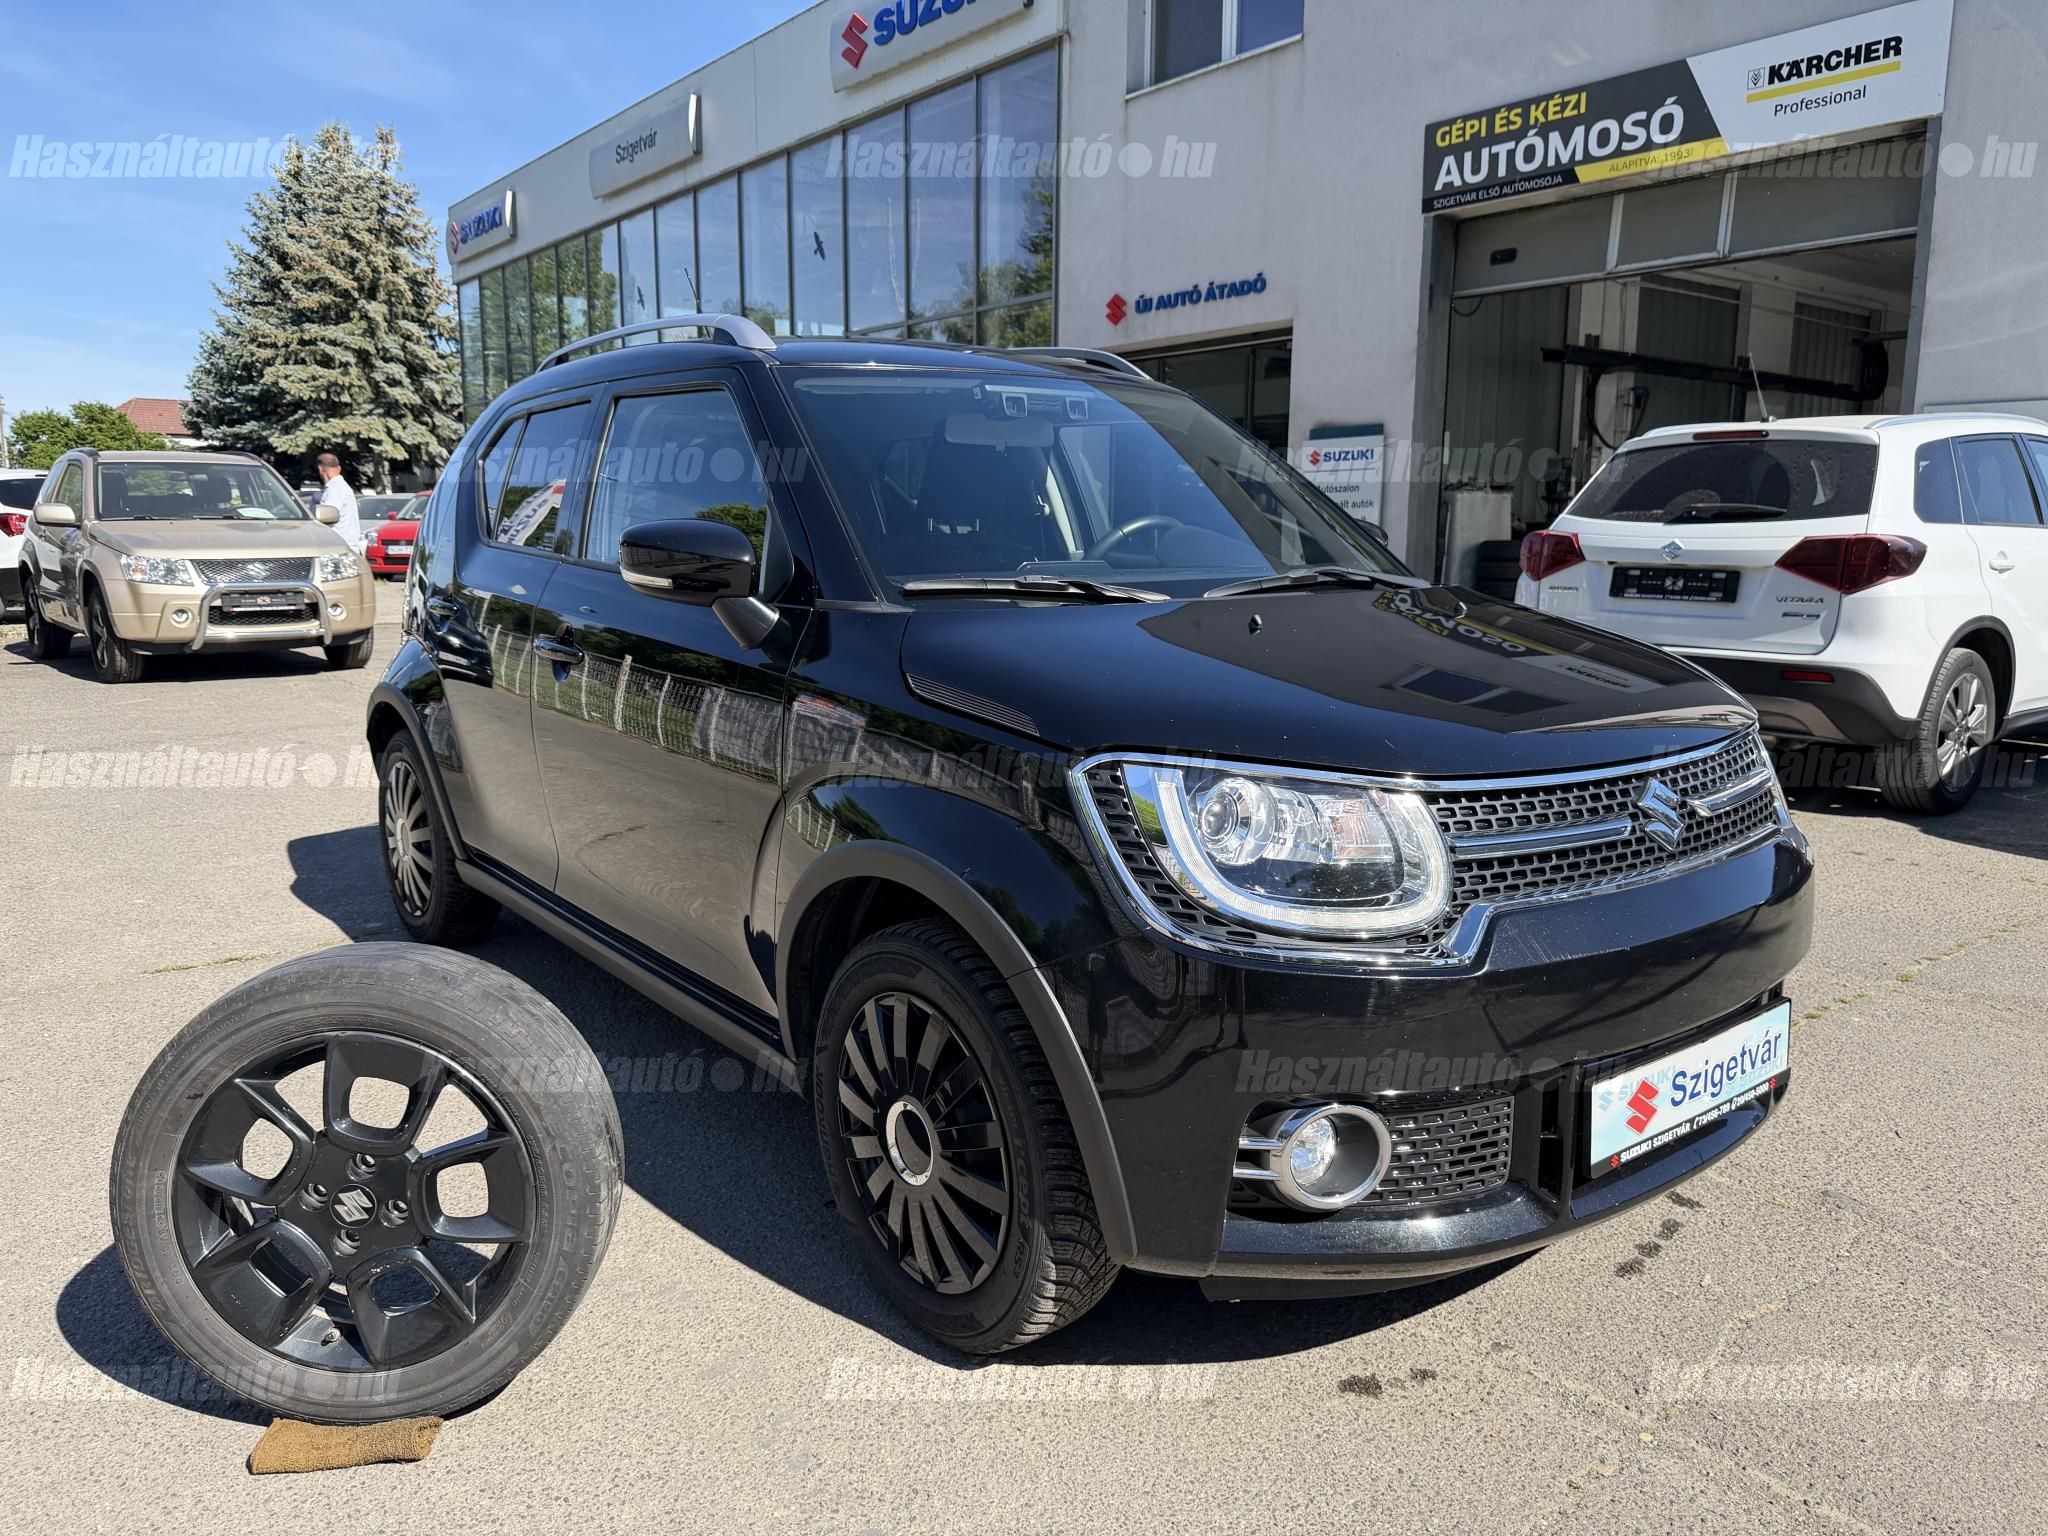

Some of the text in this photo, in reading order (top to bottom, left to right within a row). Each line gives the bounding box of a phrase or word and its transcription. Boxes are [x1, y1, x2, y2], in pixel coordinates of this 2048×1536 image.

[1767, 35, 1903, 85] KÄRCHER
[1436, 91, 1587, 148] GÉPI ÉS KÉZI
[1774, 85, 1867, 117] Professional
[615, 129, 658, 165] Szigetvár
[1434, 96, 1684, 192] AUTÓMOSÓ
[1433, 192, 1477, 210] SZIGETVÁR
[459, 203, 503, 244] SUZUKI
[1135, 271, 1267, 314] ÚJ AUTÓ ÁTADÓ
[1323, 448, 1375, 463] SUZUKI
[1671, 1030, 1782, 1107] Szigetvár
[1620, 1139, 1652, 1163] SUZUKI
[1652, 1122, 1691, 1148] SZIGETVÁR
